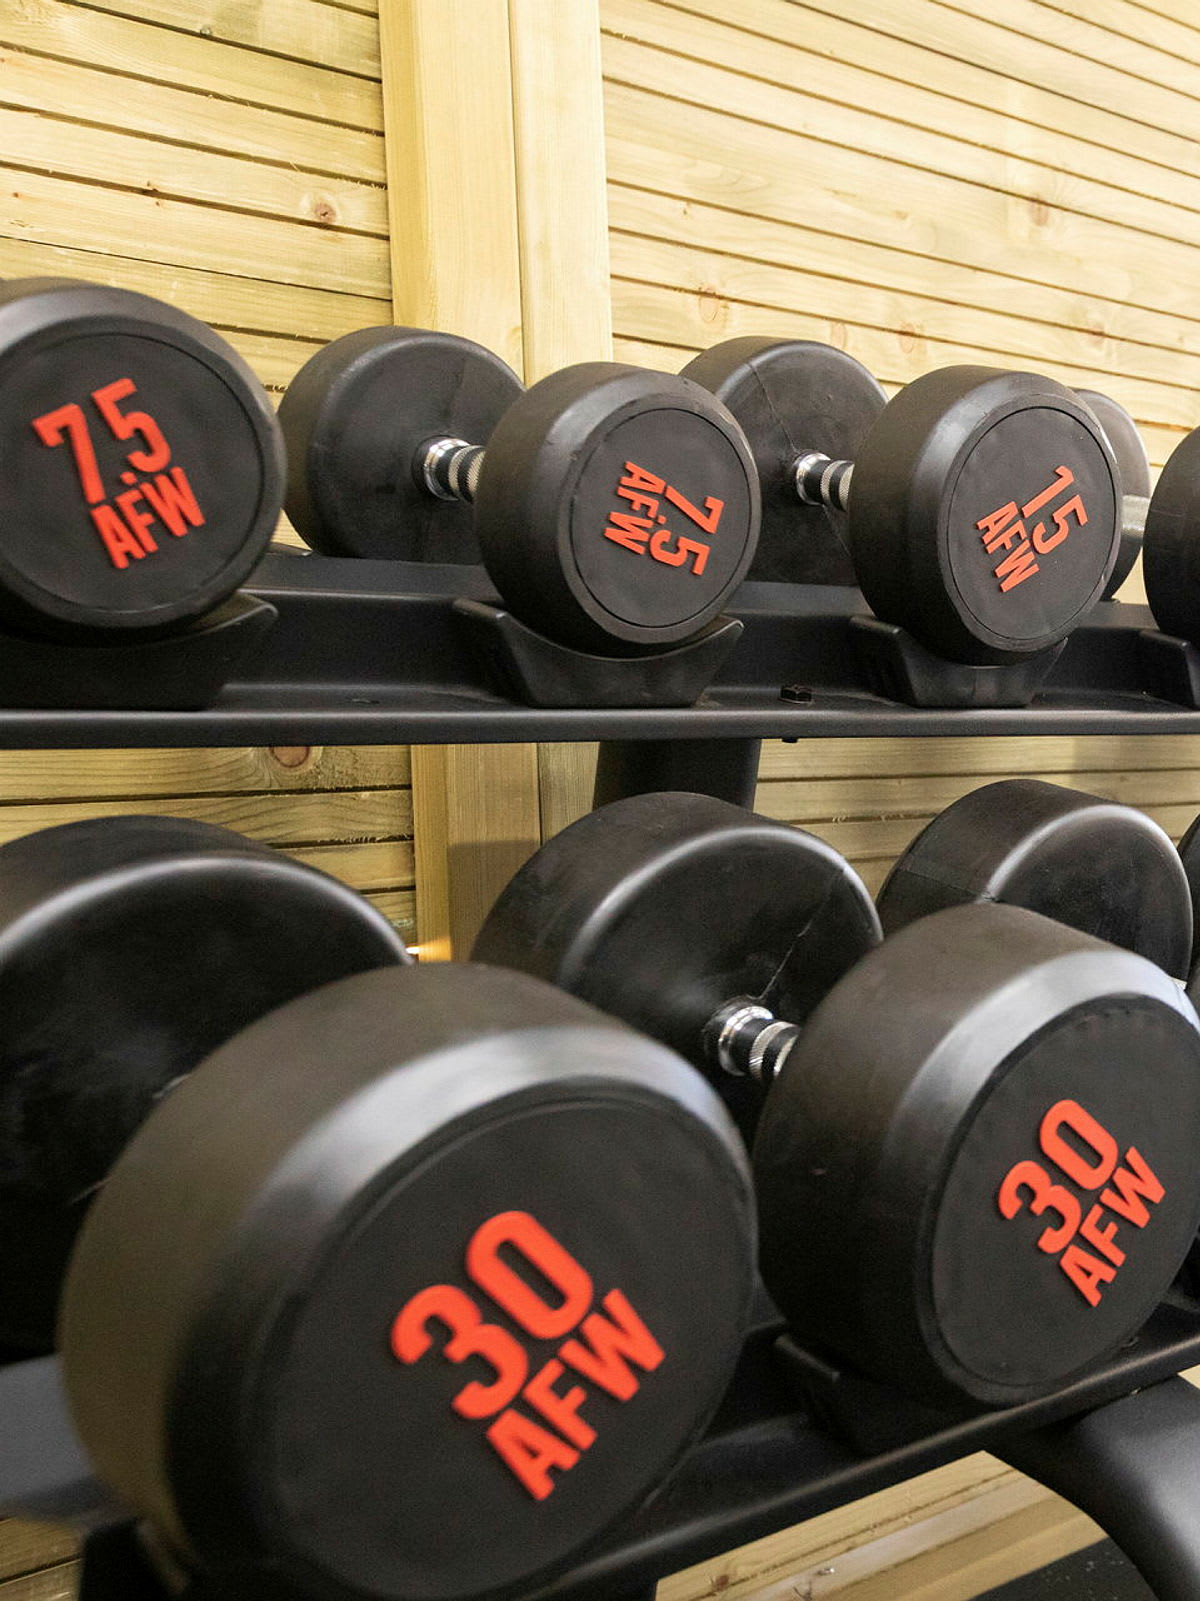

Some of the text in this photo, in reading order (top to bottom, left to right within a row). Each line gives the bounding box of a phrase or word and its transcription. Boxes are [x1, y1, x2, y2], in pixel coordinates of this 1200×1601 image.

[32, 378, 172, 504] 7.5
[90, 467, 206, 570] AFW
[603, 461, 667, 555] AFW
[649, 486, 725, 576] 7.5
[975, 501, 1040, 593] AFW
[1021, 465, 1089, 554] 15
[998, 1100, 1119, 1254] 30
[1059, 1146, 1166, 1308] AFW
[390, 1211, 594, 1419] 30
[486, 1288, 666, 1501] AFW
